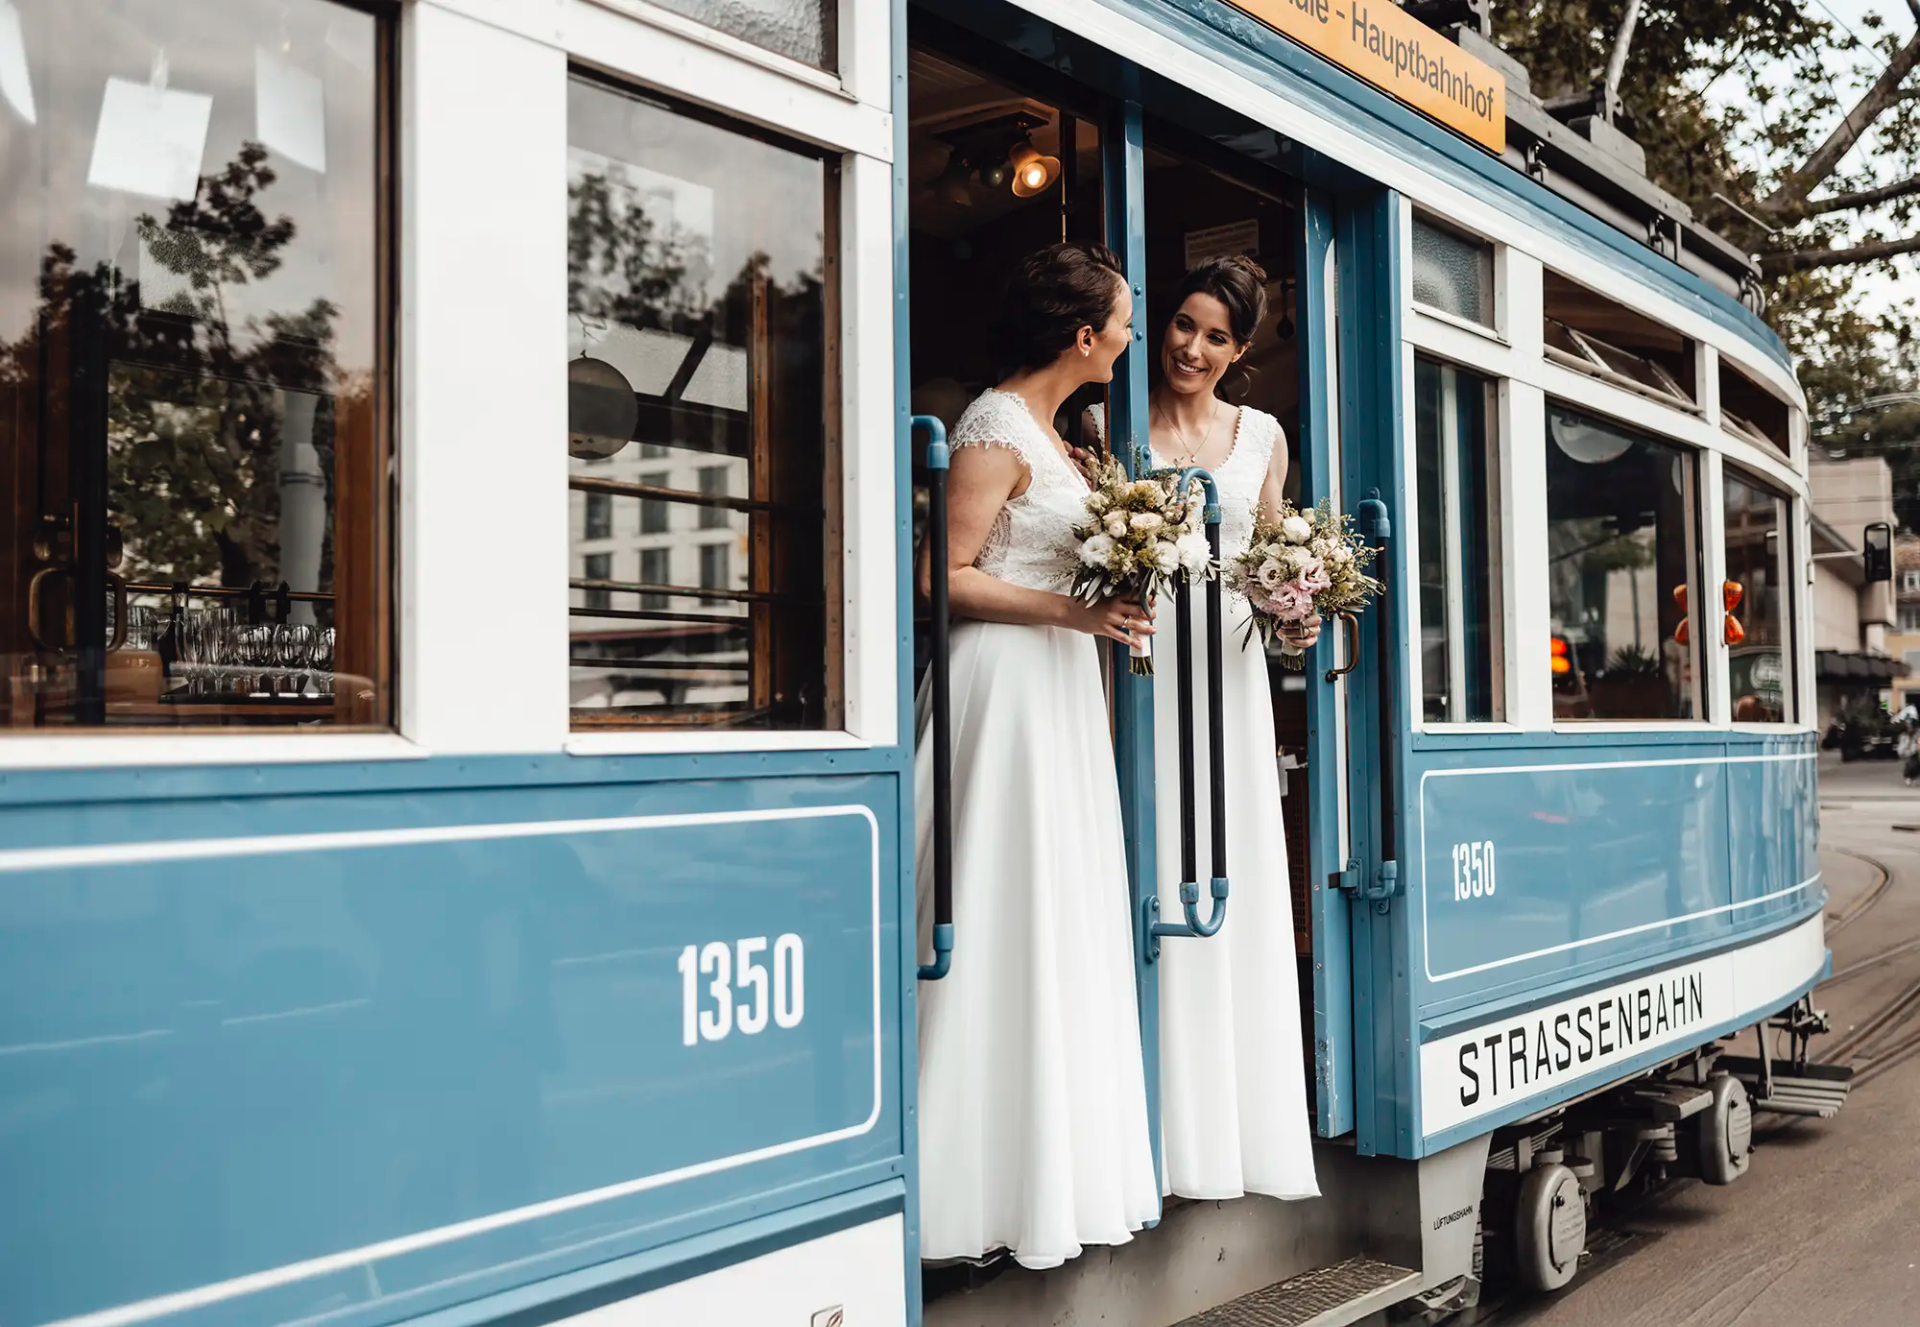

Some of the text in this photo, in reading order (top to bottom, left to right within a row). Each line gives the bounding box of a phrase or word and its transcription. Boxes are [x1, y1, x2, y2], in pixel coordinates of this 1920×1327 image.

[1351, 1, 1495, 122] Hauptbahnhof
[1452, 840, 1496, 902] 1350
[677, 932, 805, 1047] 1350
[1459, 971, 1703, 1108] STRASSENBAHN
[1433, 1204, 1473, 1231] LÜFTUNGSHAHN
